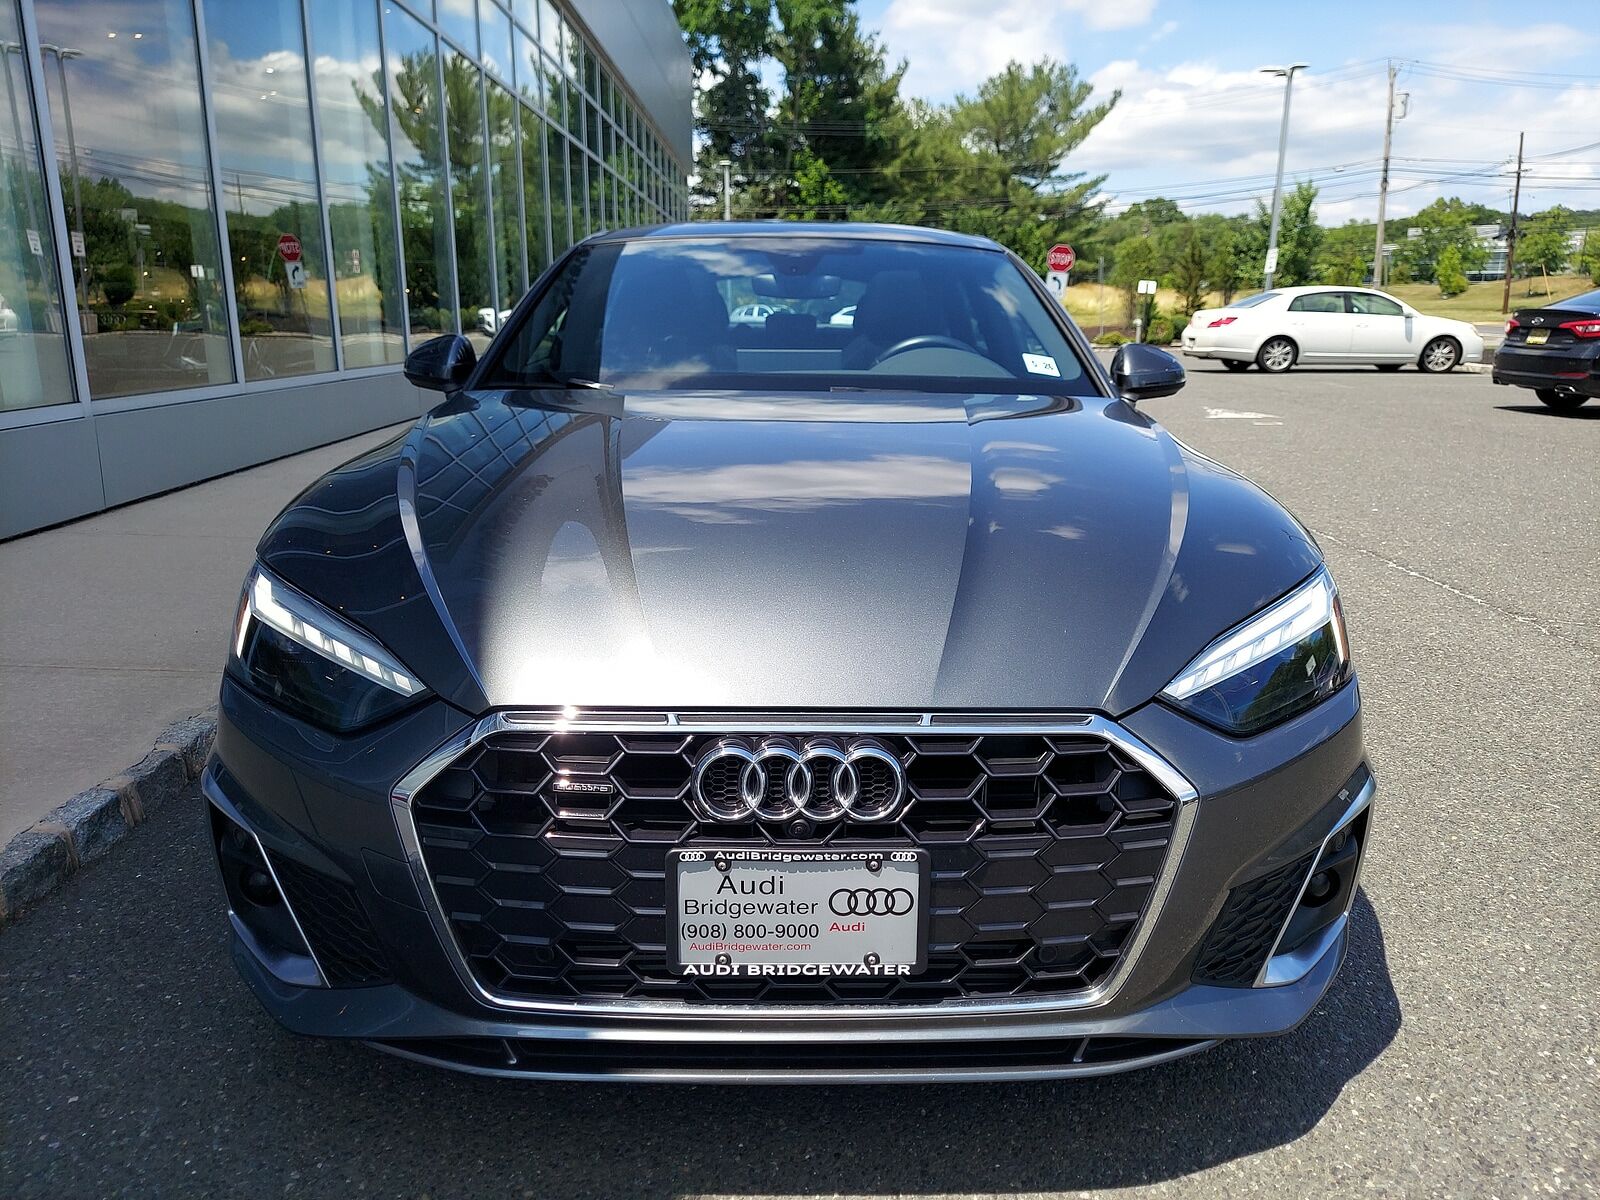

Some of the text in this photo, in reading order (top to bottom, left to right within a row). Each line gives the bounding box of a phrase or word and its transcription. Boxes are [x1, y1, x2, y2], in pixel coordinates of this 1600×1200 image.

[1049, 252, 1073, 265] STOP
[714, 851, 883, 862] AudiBridgewater.com
[716, 875, 785, 895] Audi
[684, 899, 819, 918] Bridgewater
[681, 923, 820, 940] (908) 800-9000
[829, 922, 866, 932] Audi
[690, 942, 811, 952] AudiBridgewater.com
[683, 964, 911, 976] AUDI BRIDGEWATER
